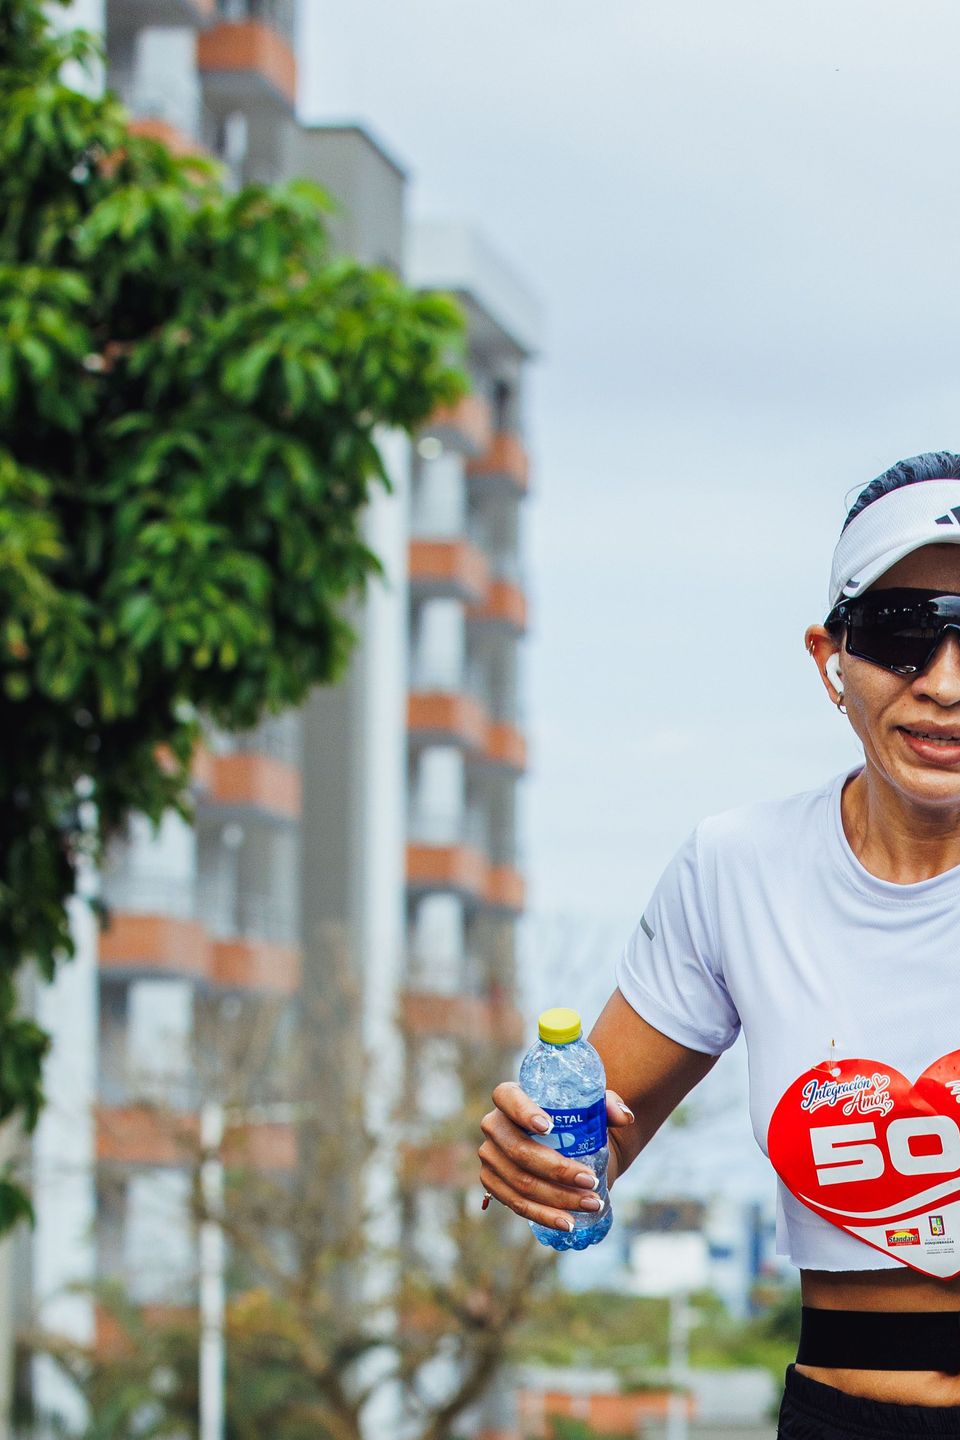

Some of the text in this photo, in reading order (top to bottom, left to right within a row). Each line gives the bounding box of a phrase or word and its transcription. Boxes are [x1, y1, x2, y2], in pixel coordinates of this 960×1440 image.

[801, 1074, 873, 1110] Integración
[843, 1090, 890, 1116] Amor
[551, 1114, 583, 1124] ISTAL
[888, 1233, 918, 1243] Standard
